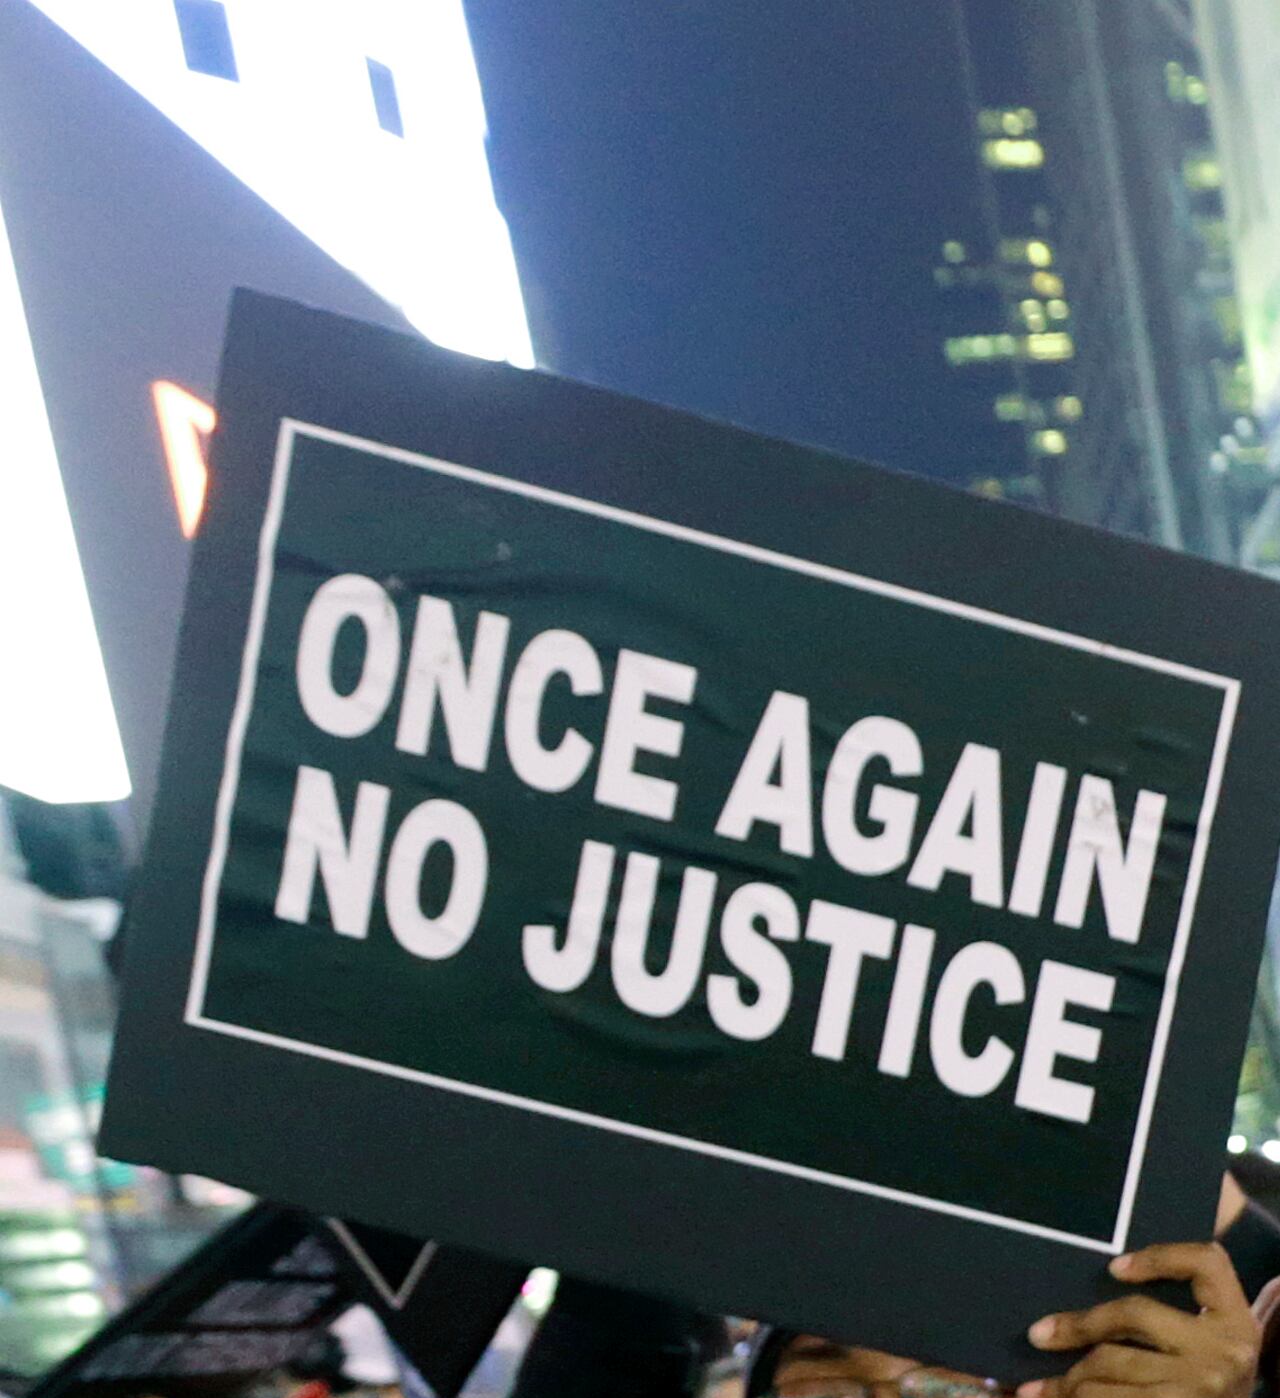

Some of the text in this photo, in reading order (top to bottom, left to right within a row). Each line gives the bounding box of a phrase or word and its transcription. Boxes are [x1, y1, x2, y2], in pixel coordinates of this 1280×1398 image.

[297, 574, 697, 820] ONCE
[715, 691, 1166, 943] AGAIN
[276, 766, 487, 959] NO
[523, 840, 1115, 1123] JUSTICE
